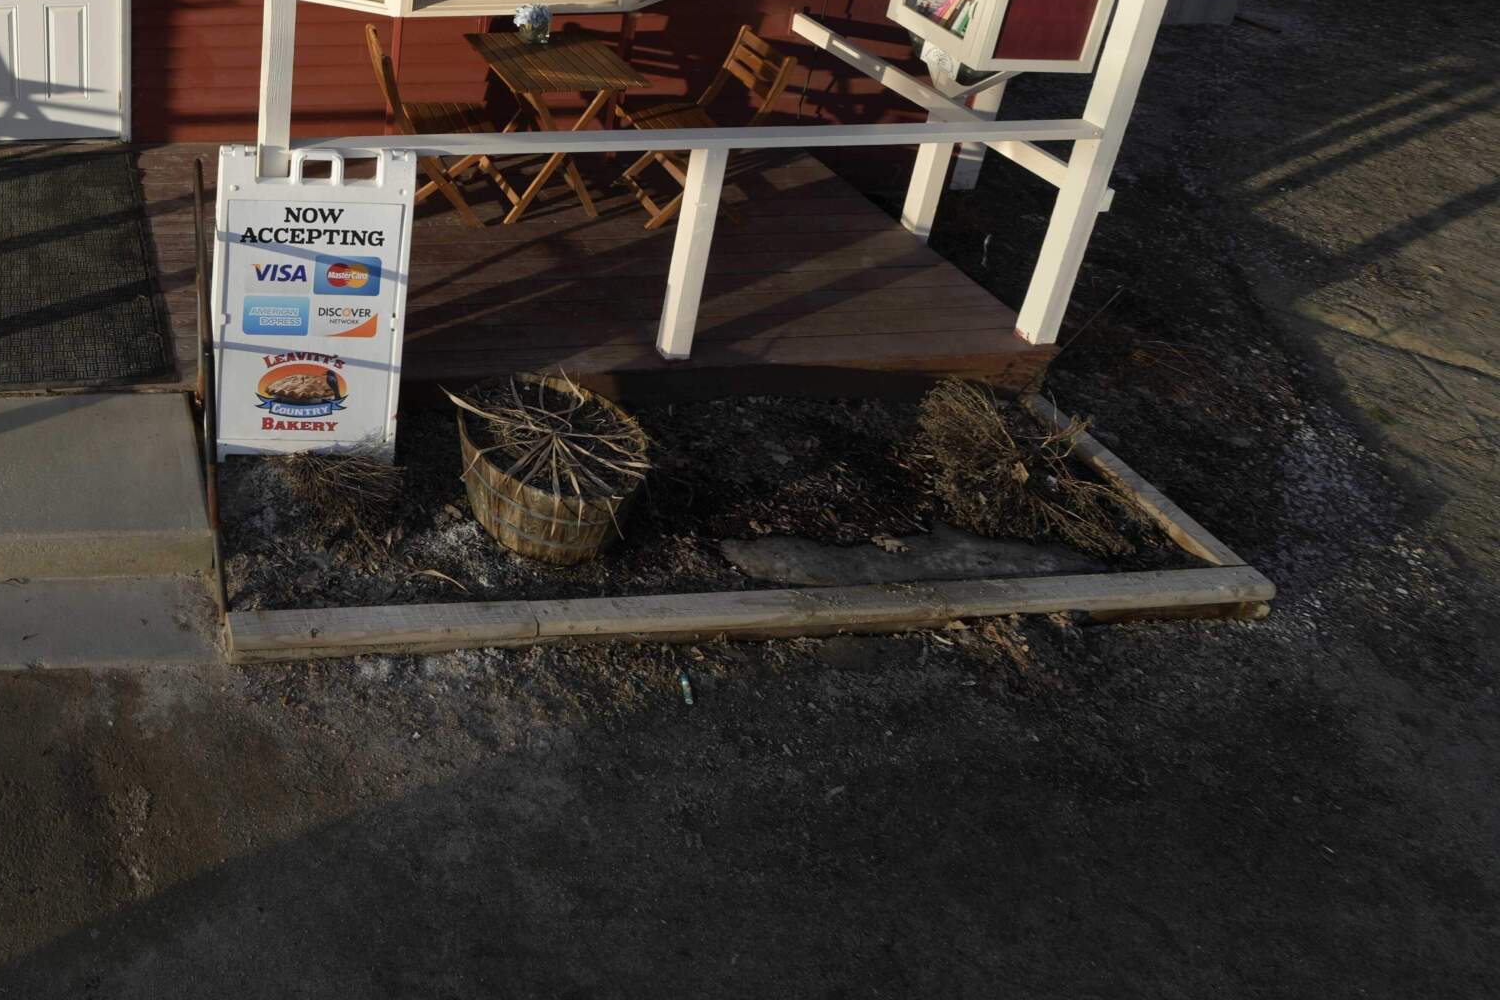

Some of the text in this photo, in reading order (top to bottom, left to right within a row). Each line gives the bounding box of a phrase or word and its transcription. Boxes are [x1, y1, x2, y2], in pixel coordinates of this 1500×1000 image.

[284, 206, 345, 224] NOW
[239, 226, 386, 247] ACCEPTING
[251, 263, 308, 283] VISA
[327, 270, 369, 281] MasterCard
[249, 306, 300, 317] AMERICAN
[317, 306, 372, 319] DISCOVER
[260, 316, 302, 327] EXPRESS
[263, 351, 345, 369] LEAVITT'S
[272, 404, 329, 417] COUNTRY
[261, 417, 338, 432] BAKERY
